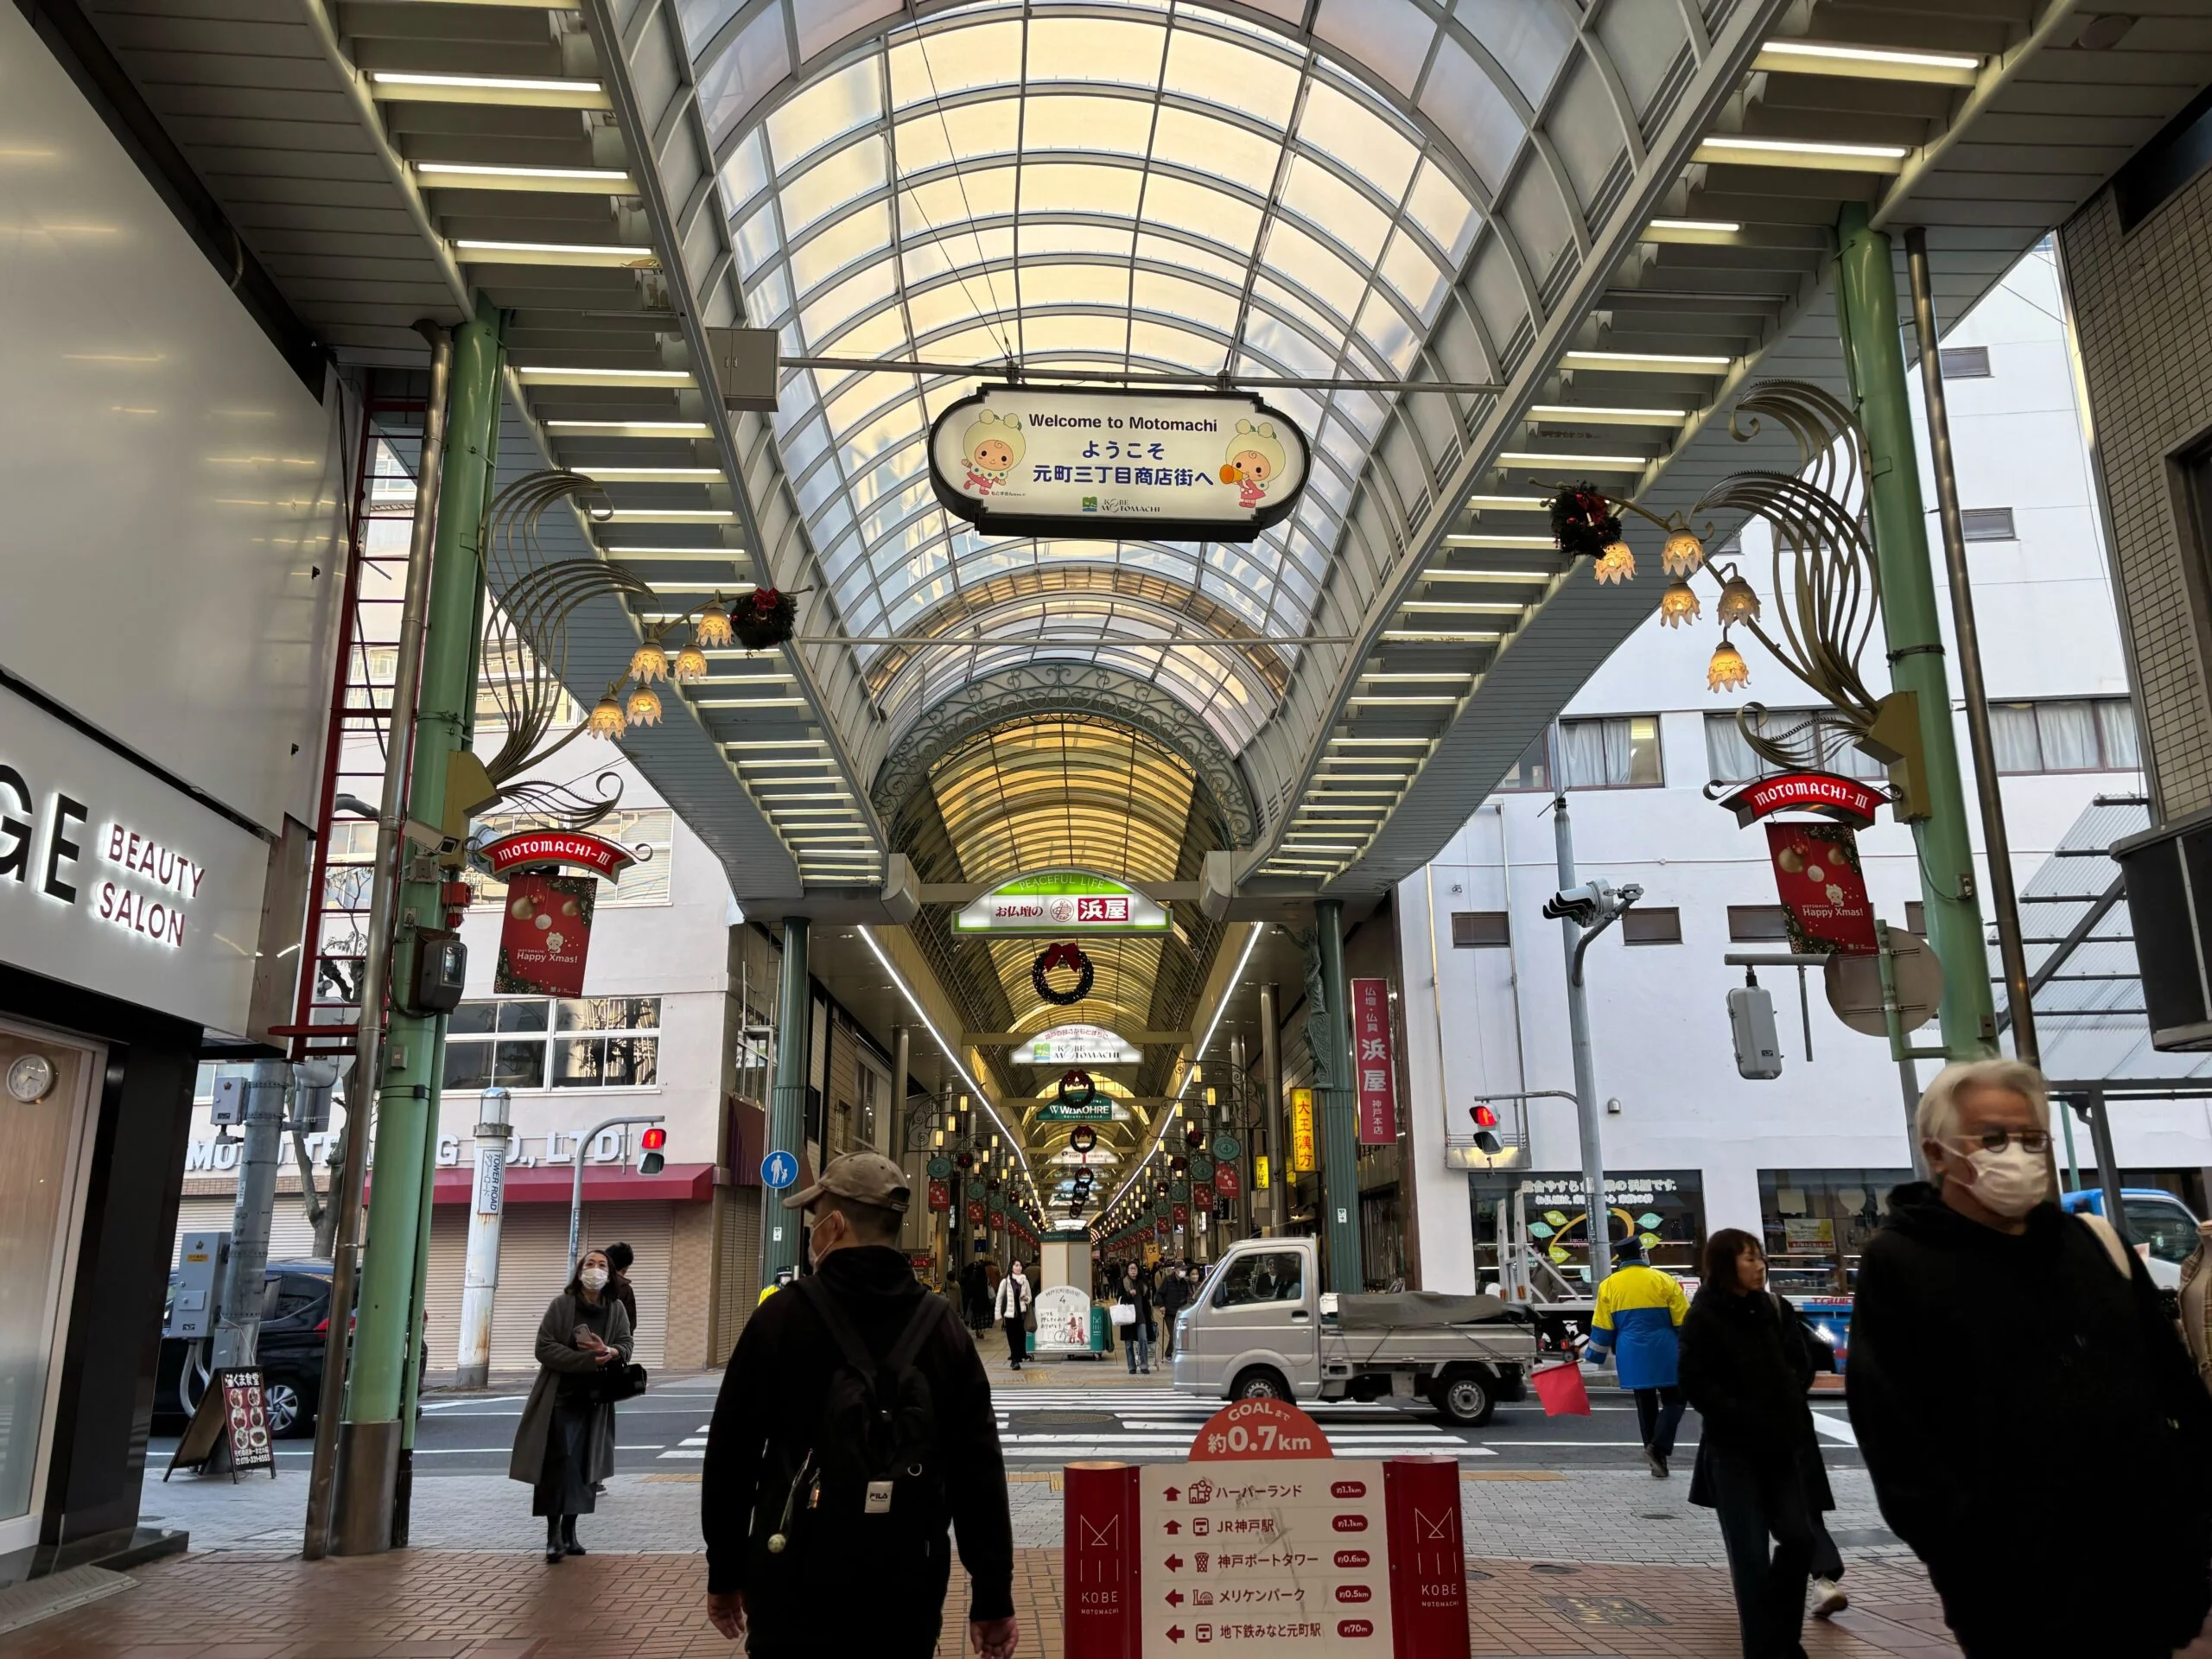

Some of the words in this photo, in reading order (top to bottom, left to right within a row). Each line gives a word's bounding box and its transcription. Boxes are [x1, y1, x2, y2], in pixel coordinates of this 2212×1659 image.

[1029, 414, 1102, 429] Welcome
[1108, 416, 1123, 429] to
[1129, 416, 1217, 432] Motomachi
[1082, 440, 1165, 461] ようこそ
[1033, 464, 1214, 486] 元町三丁目商店街へ
[1101, 504, 1161, 513] MOTOMACHI
[107, 823, 206, 899] BEAUTY
[1019, 874, 1076, 891] PEACEFUL
[1080, 877, 1106, 889] LIFE
[99, 881, 186, 948] SALON
[995, 906, 1044, 918] お仏壇の
[1080, 899, 1127, 920] 浜屋
[1802, 907, 1834, 918] Happy
[1835, 907, 1864, 917] Xmas!
[517, 952, 547, 963] Happy
[549, 953, 578, 963] Xmas!
[1053, 1051, 1120, 1059] MOTOMACHI
[1058, 1044, 1086, 1052] KOBE
[1361, 1037, 1387, 1092] 浜屋
[1059, 1105, 1109, 1115] WAKOHRE
[1372, 1099, 1383, 1135] 神戸本店
[1298, 1100, 1313, 1166] 大王漢方
[482, 1153, 493, 1197] タワーロード
[491, 1154, 501, 1184] TOWER
[1257, 1162, 1266, 1187] すっぽん
[489, 1184, 499, 1211] ROAD
[1059, 1295, 1066, 1304] 4
[233, 1372, 260, 1387] くま食堂
[1208, 1425, 1312, 1453] 約0.7km
[1216, 1484, 1303, 1498] ハーバーランド
[1217, 1518, 1274, 1534] JR神戸駅
[1217, 1554, 1319, 1569] 神戸ポートタワー
[1338, 1555, 1368, 1564] 約0.6km
[1081, 1591, 1118, 1604] KOBE
[1219, 1588, 1306, 1604] メリケンパーク
[1339, 1590, 1370, 1599] 約0.5km
[1421, 1583, 1458, 1596] KOBE
[1219, 1622, 1321, 1639] 地下鉄みなと元町駅
[1344, 1624, 1368, 1633] 約70m
